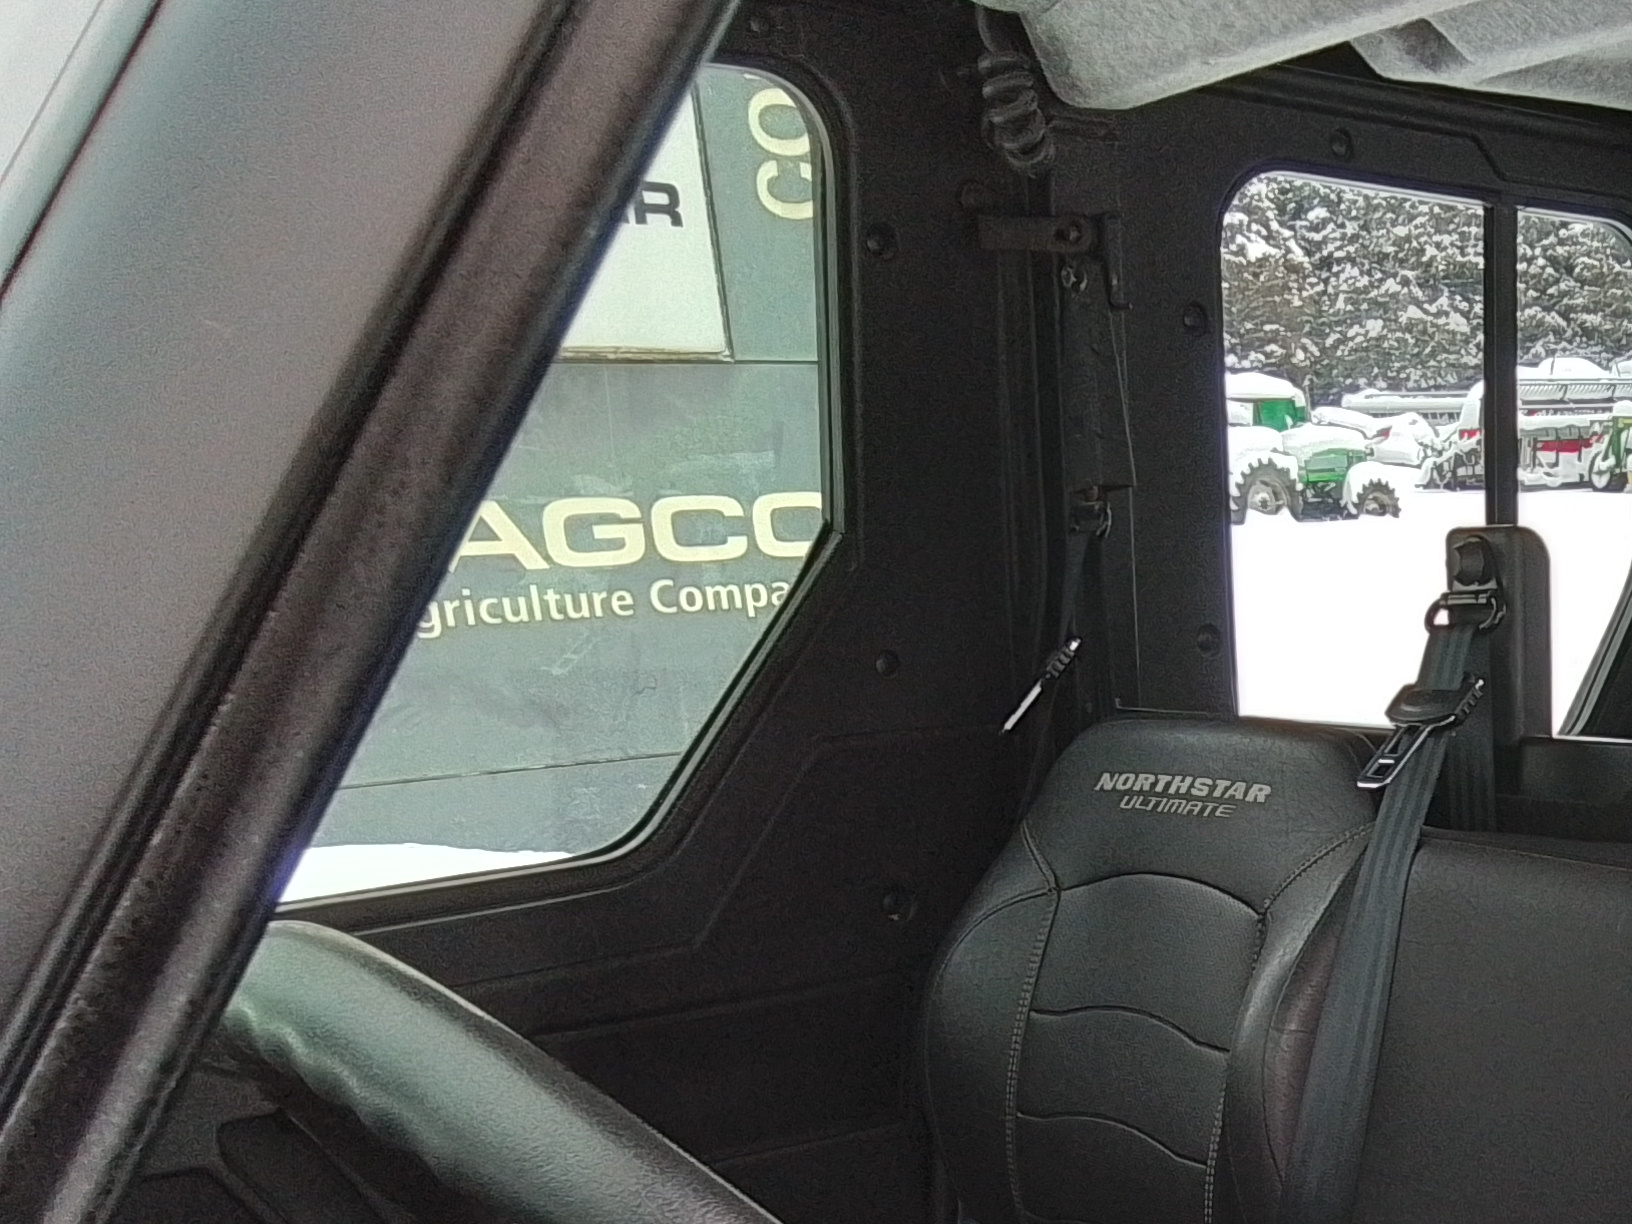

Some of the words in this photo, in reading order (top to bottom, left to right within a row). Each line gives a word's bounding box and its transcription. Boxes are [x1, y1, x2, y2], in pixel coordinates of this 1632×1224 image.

[621, 181, 684, 228] R
[1093, 771, 1273, 804] NORTHSTAR
[1119, 794, 1238, 819] ULTIMATE
